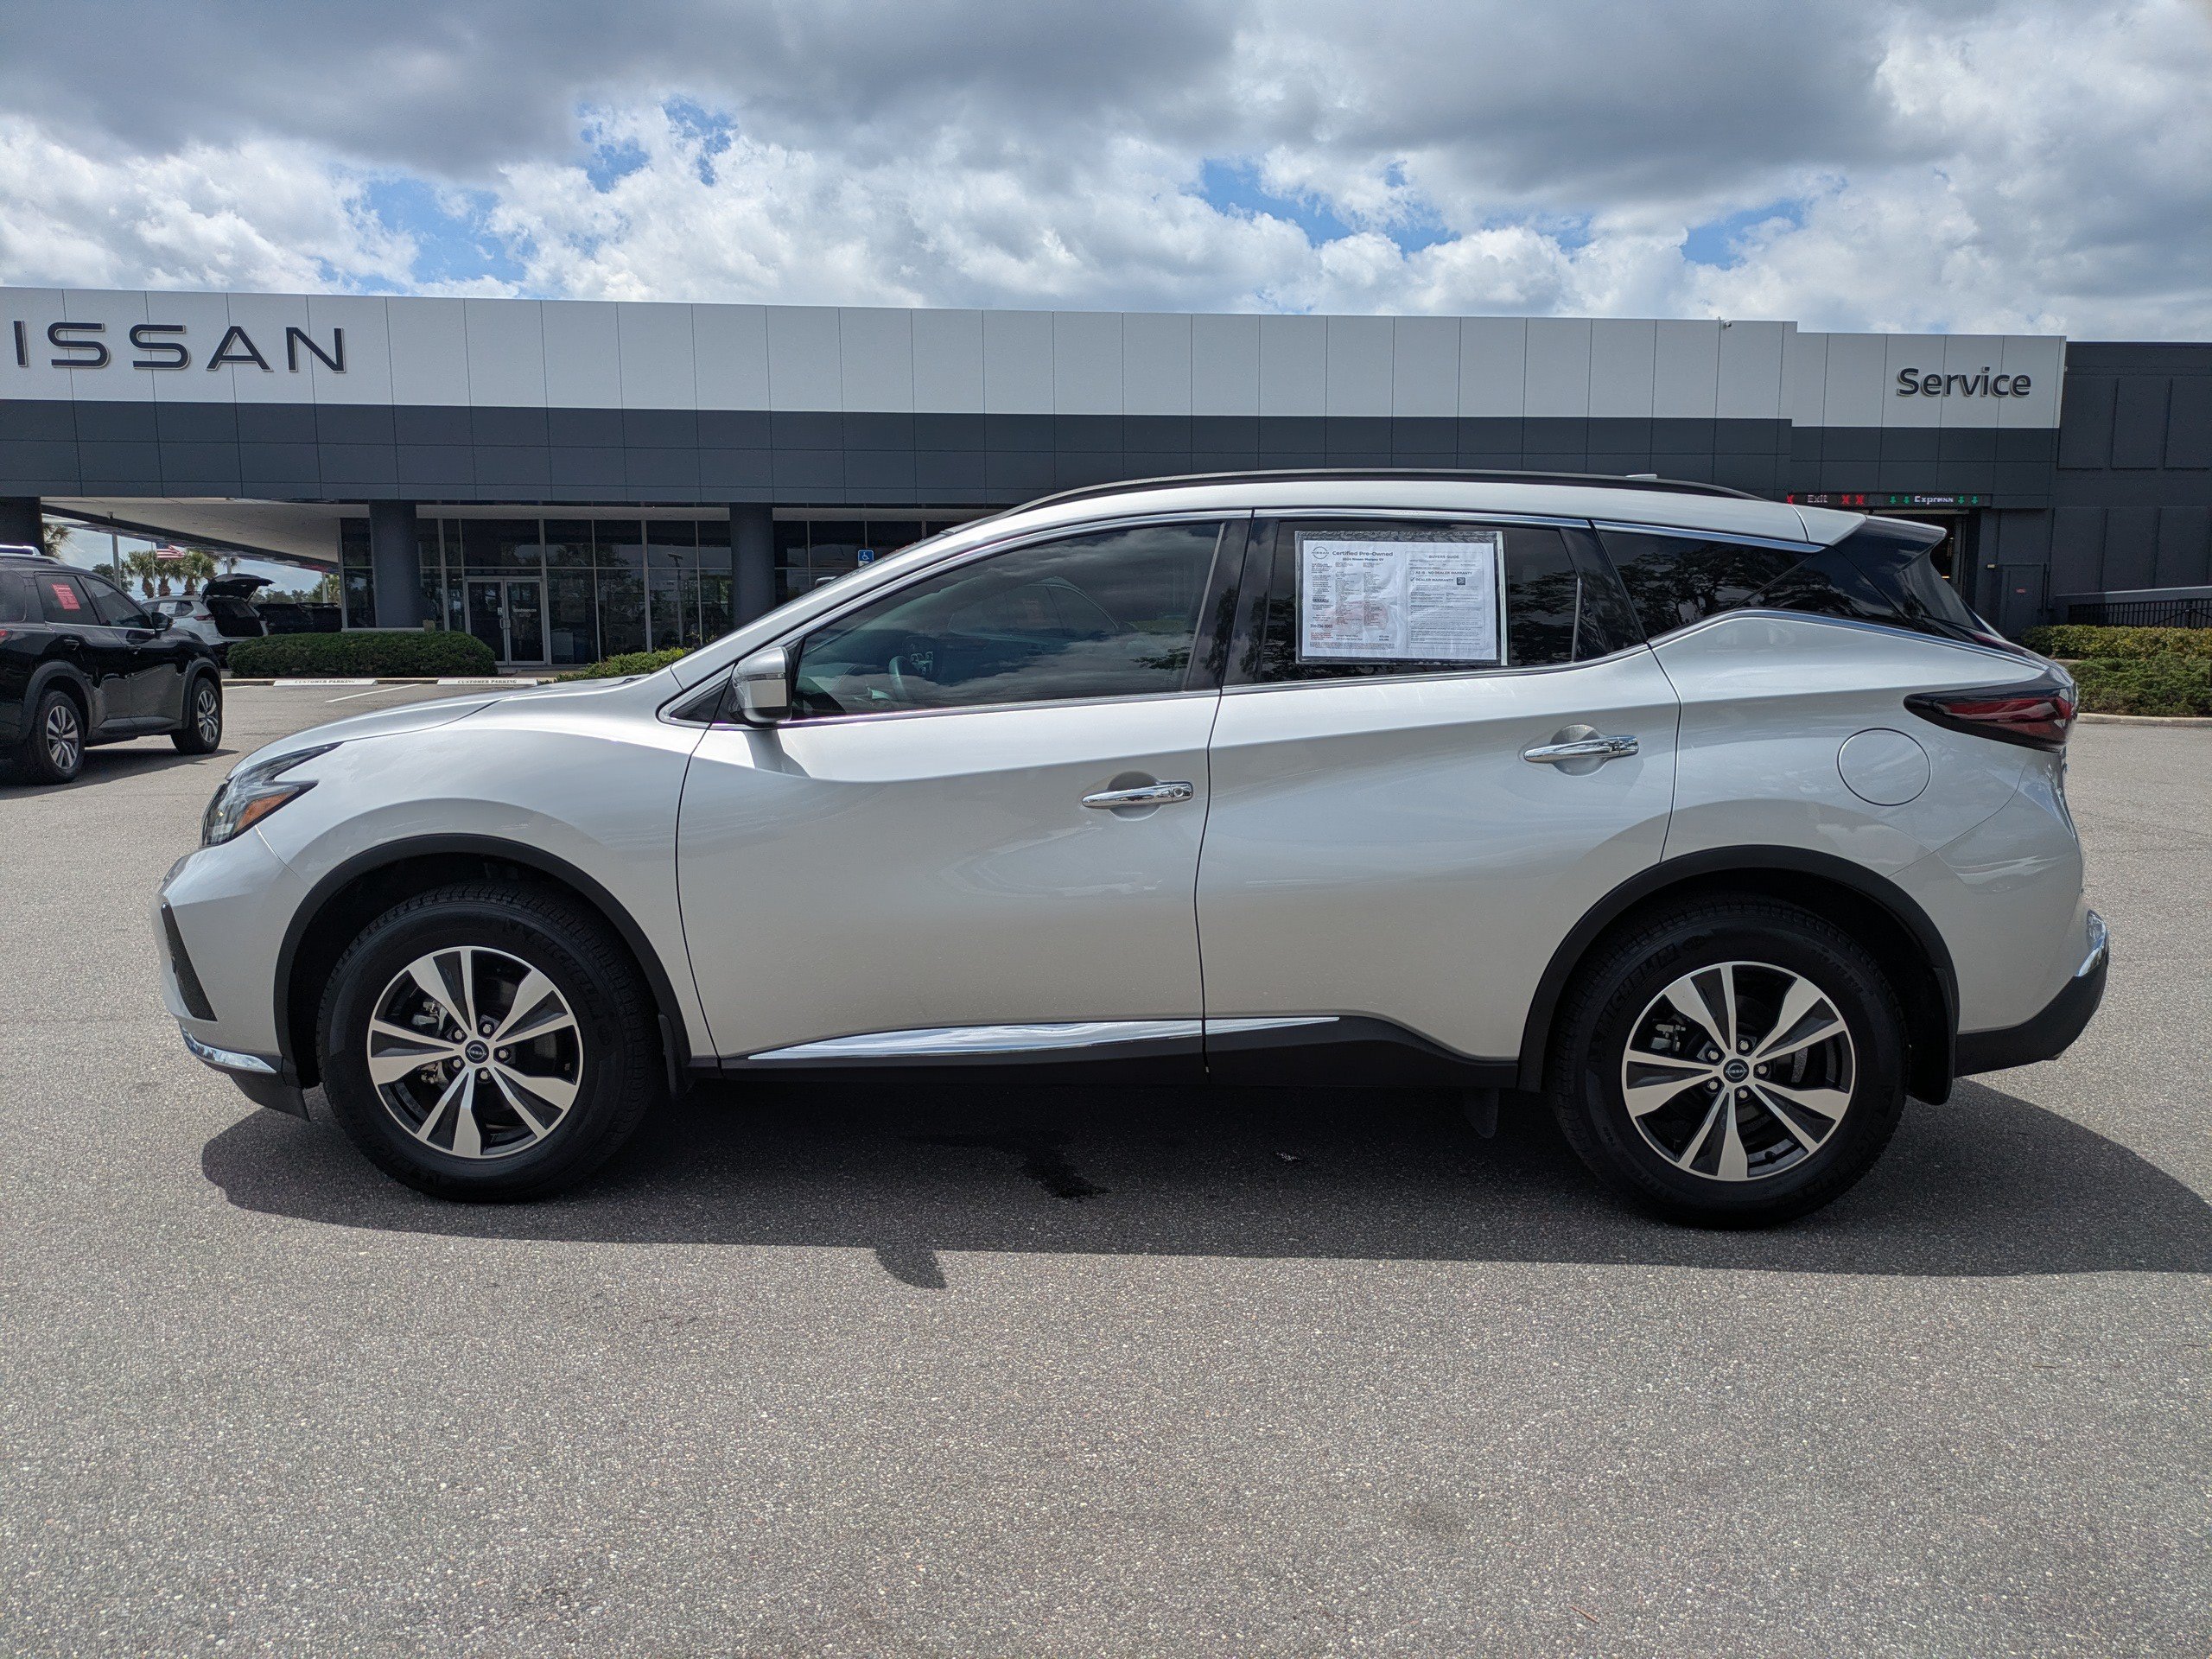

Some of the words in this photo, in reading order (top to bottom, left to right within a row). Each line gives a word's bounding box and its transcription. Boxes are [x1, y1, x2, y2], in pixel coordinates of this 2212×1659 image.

[13, 321, 346, 373] ISSAN
[1897, 366, 2031, 397] Service
[1808, 494, 1828, 503] Exit
[1914, 495, 1954, 505] Express
